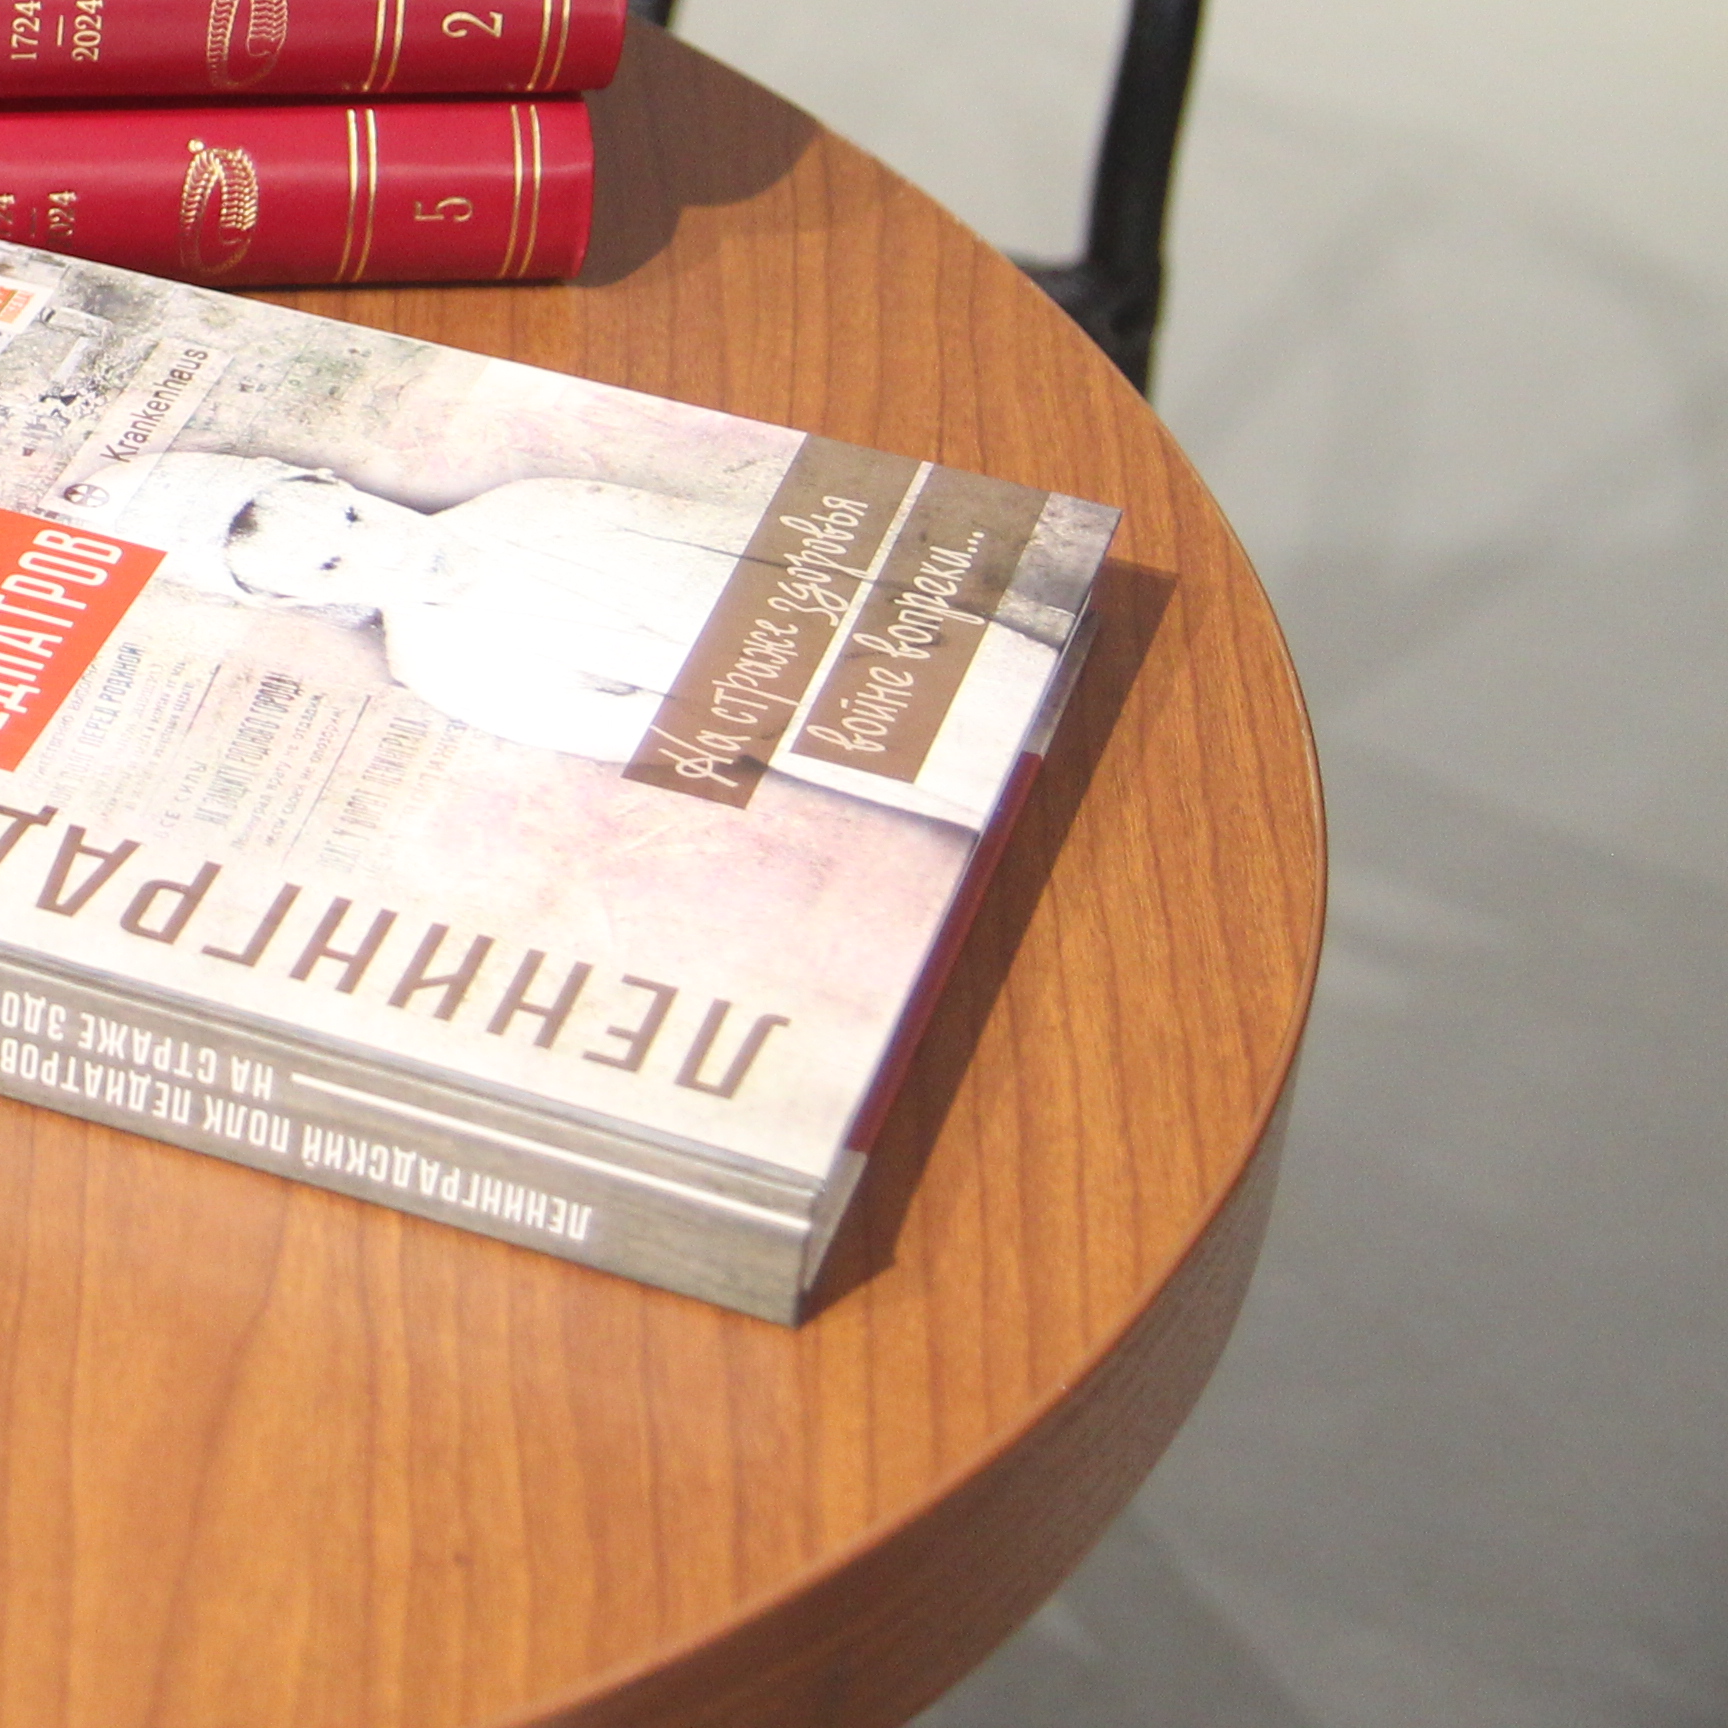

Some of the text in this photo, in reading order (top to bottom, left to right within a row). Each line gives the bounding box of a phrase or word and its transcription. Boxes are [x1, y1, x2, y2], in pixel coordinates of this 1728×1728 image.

[10, 0, 42, 63] 1724
[442, 11, 505, 38] 2
[415, 196, 473, 224] 5
[100, 348, 208, 463] Krankenhaus
[674, 494, 869, 790] На страже здоровья
[805, 666, 913, 754] войне
[79, 1019, 212, 1084] СТРАЖЕ
[221, 1056, 272, 1099] НА
[200, 1106, 289, 1154] ПОЛК
[302, 1134, 593, 1240] ЛЕНИНГРАДСКИЙ
